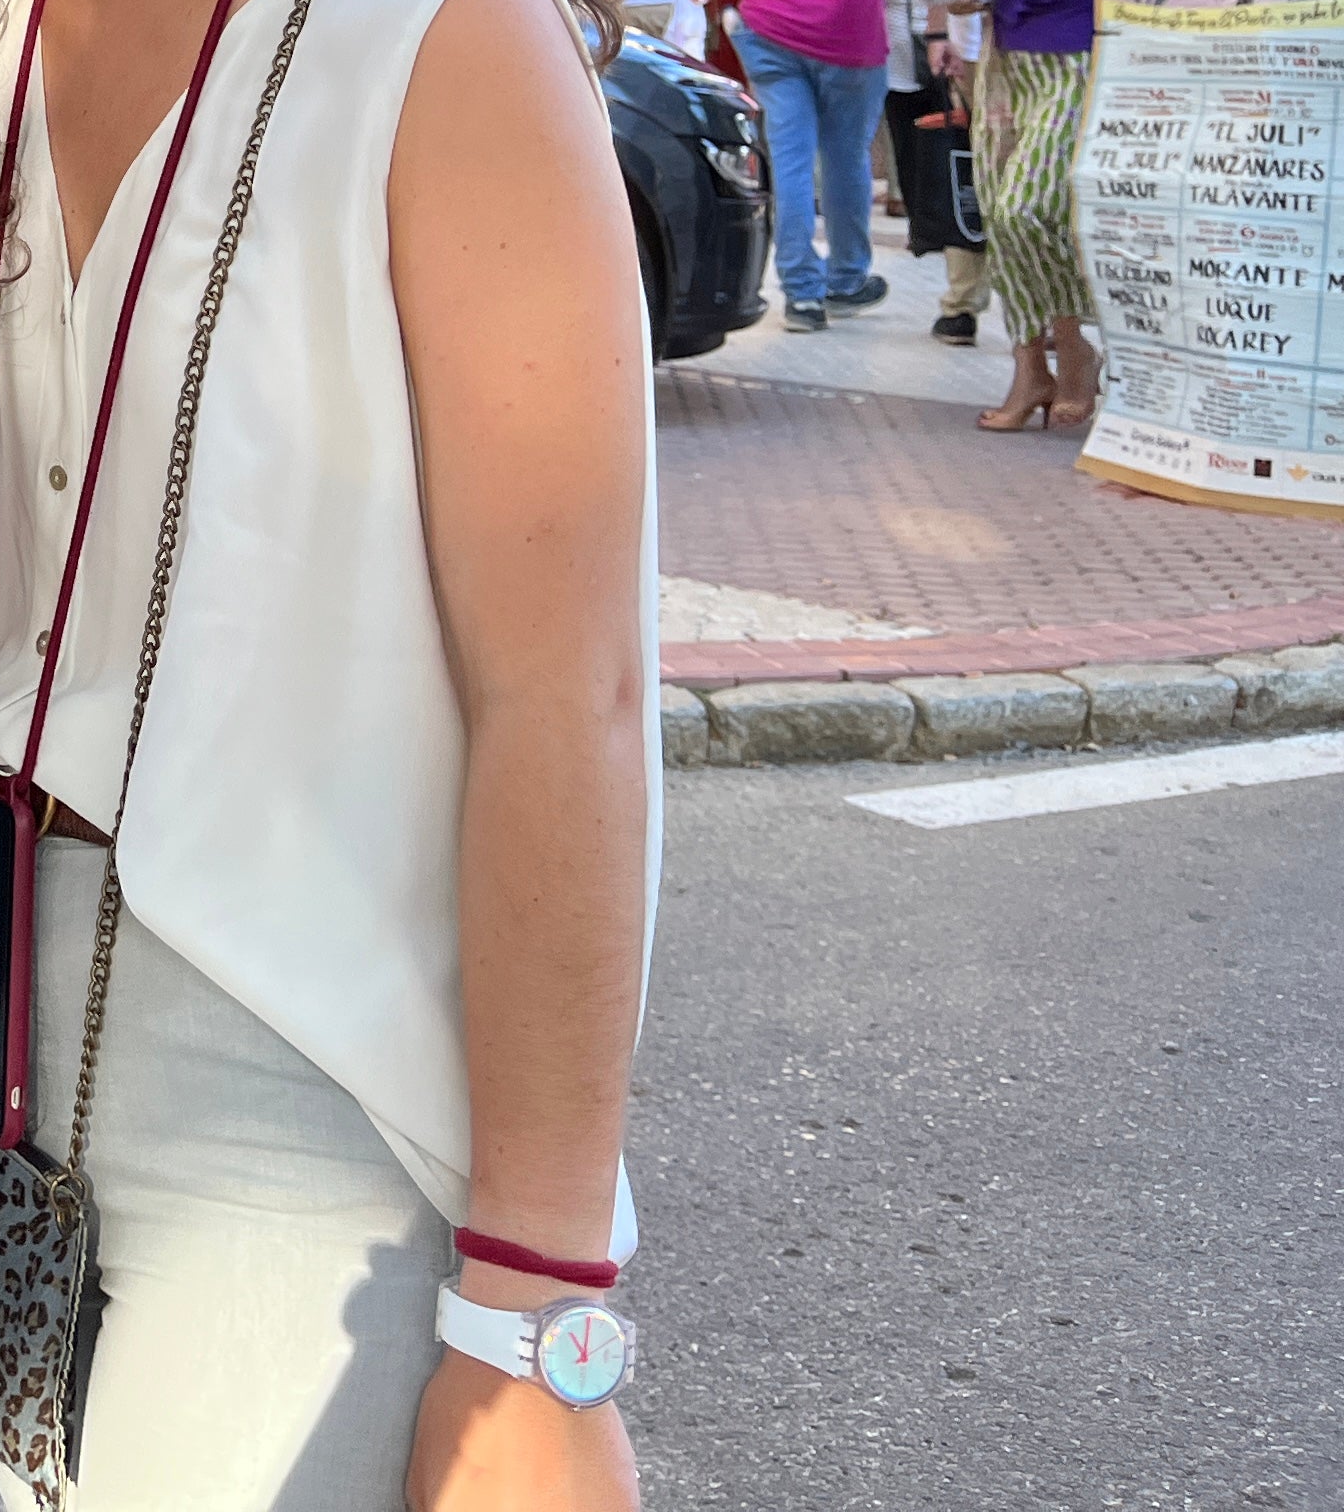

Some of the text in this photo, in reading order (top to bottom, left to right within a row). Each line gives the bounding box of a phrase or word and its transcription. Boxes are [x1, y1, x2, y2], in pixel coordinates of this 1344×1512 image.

[1098, 119, 1189, 141] MORANTE
[1192, 152, 1325, 182] MANZANARES
[1097, 179, 1158, 199] LUQUE
[1191, 184, 1320, 213] TALAVANTE
[1189, 258, 1310, 287] MORANTE
[1206, 296, 1278, 323] LUQUE
[1196, 323, 1292, 356] ROCA REY
